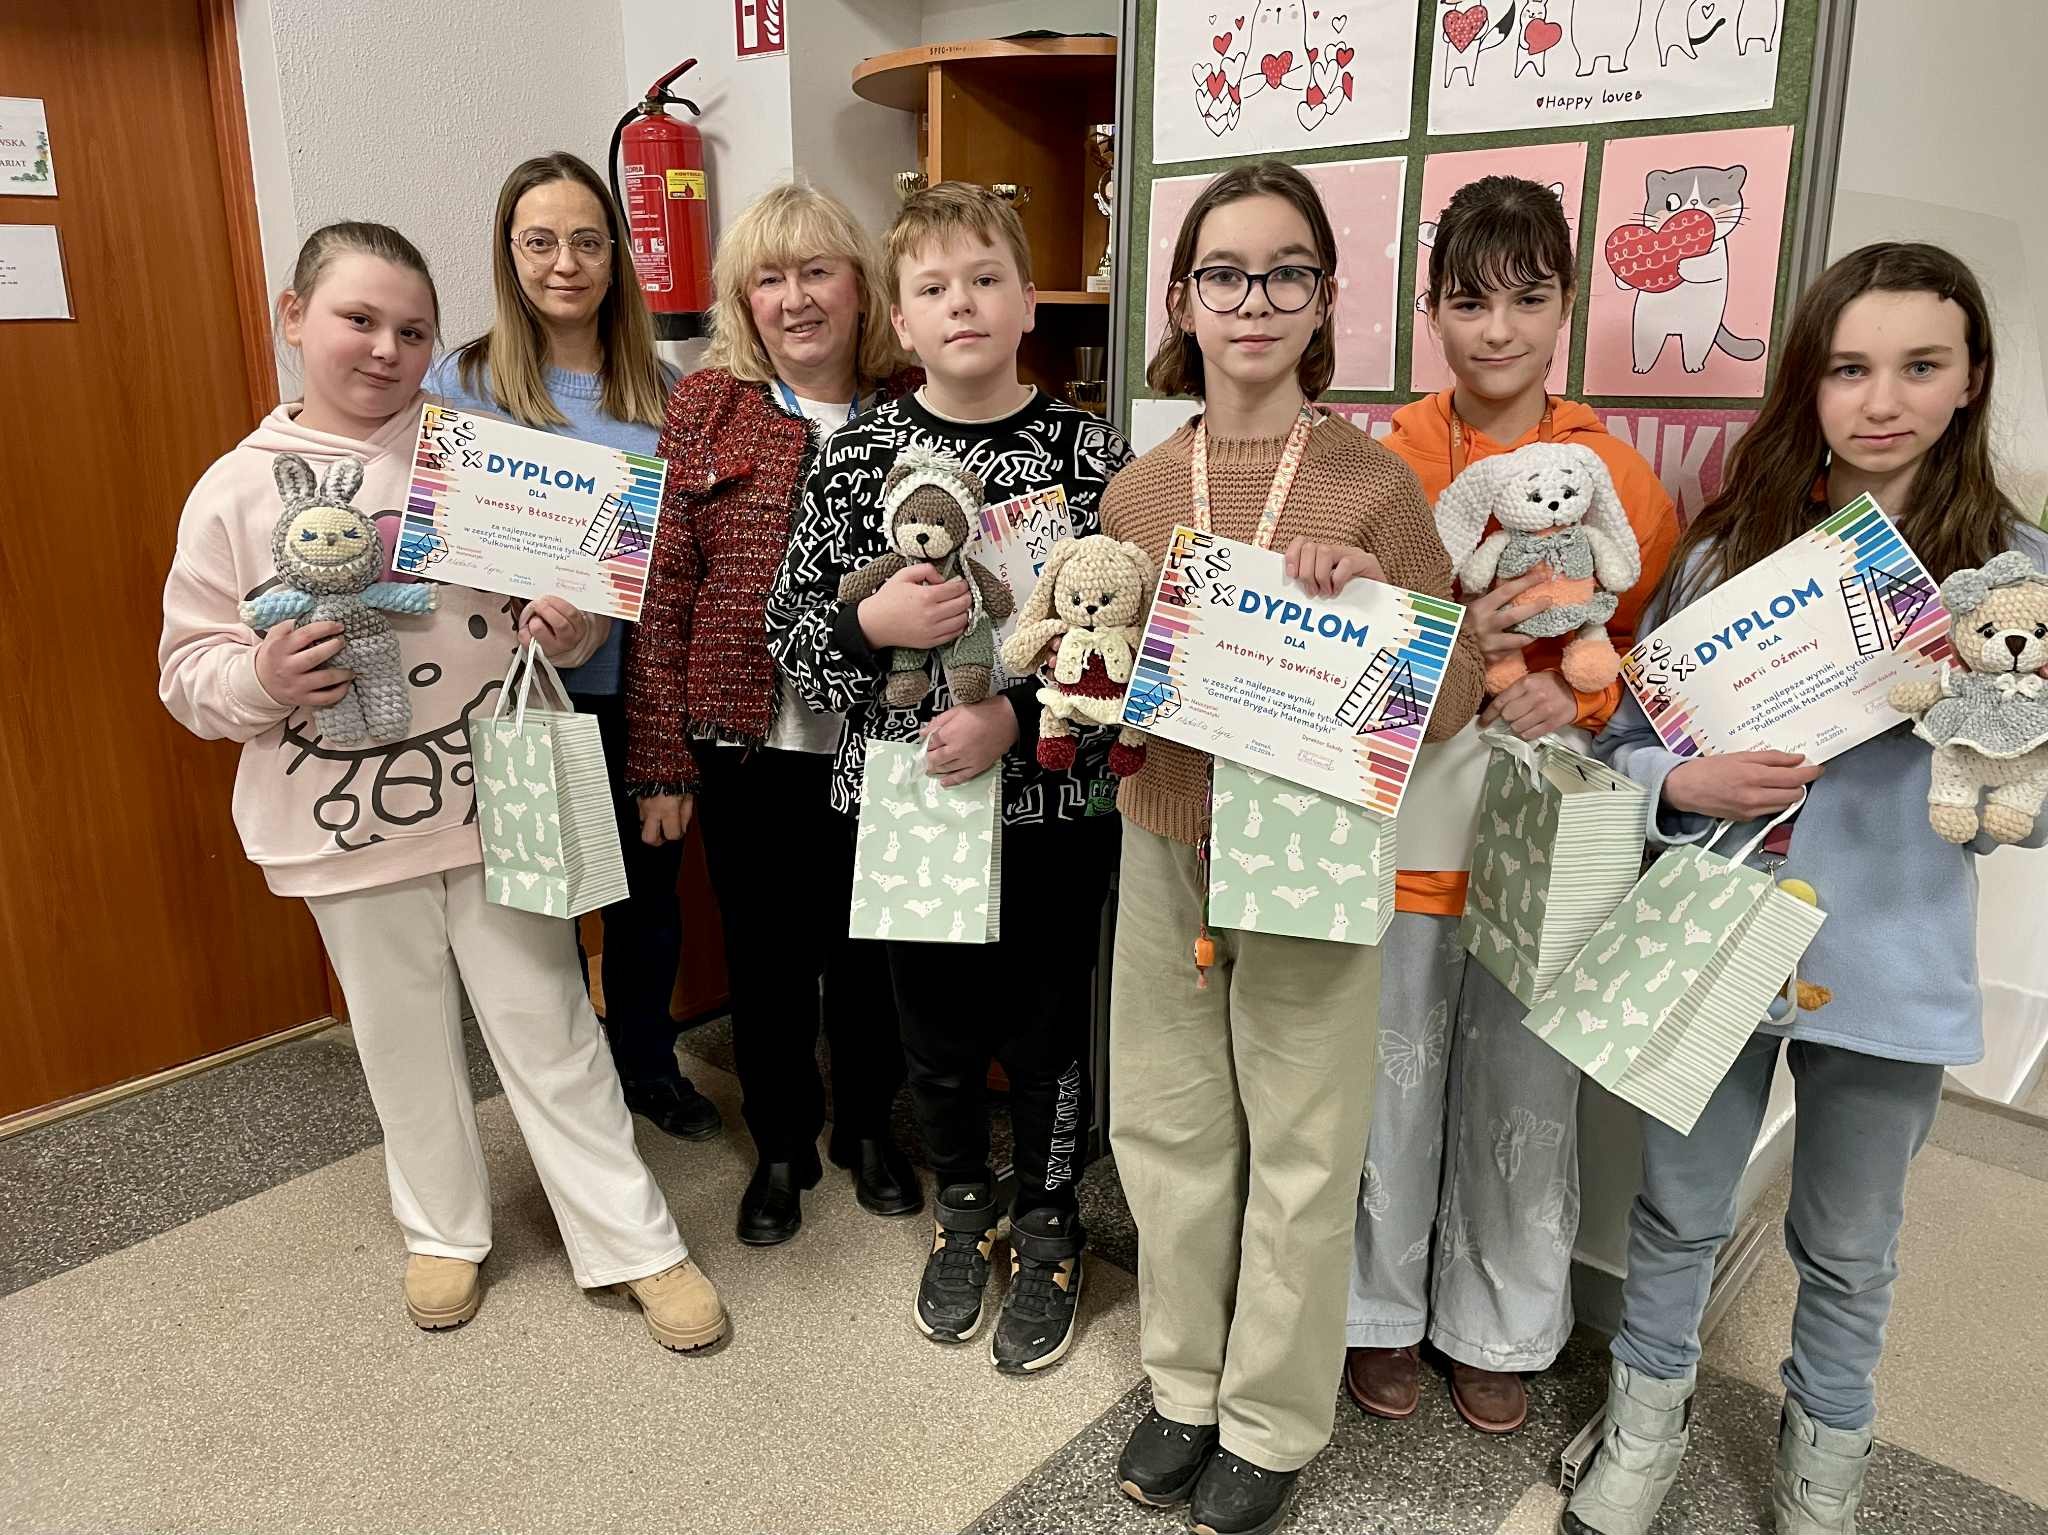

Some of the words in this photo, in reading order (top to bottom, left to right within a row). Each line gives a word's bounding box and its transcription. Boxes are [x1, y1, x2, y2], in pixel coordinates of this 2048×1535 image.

[1546, 96, 1593, 110] Happy
[1603, 89, 1633, 103] love
[486, 454, 596, 495] DYPLOM
[529, 489, 546, 499] DLA
[476, 495, 523, 514] Vanessy
[528, 507, 587, 527] Błaszczyk
[1238, 590, 1369, 647] DYPLOM
[1694, 578, 1824, 666] DYPLOM
[1284, 636, 1305, 650] DLA
[1758, 635, 1782, 650] DLA
[1216, 640, 1274, 666] Antoniny
[1280, 658, 1347, 688] Sowińskiej
[1733, 669, 1766, 692] Marii
[1771, 639, 1818, 668] Oźminy
[1763, 680, 1804, 704] najlepsze
[1806, 662, 1835, 681] wyniki
[1799, 670, 1844, 696] uzyskanie
[1846, 650, 1874, 671] tytułu
[1206, 687, 1241, 704] "Generał
[1243, 700, 1278, 718] Brygady
[1280, 711, 1336, 734] Matematyki"
[1234, 676, 1244, 684] za
[1246, 680, 1286, 696] najlepsze
[1288, 694, 1314, 706] wyniki
[1750, 704, 1801, 732] "Pułkownik
[1801, 668, 1858, 706] Matematyki"
[1272, 700, 1315, 717] uzyskanie
[1318, 713, 1345, 727] tytułu
